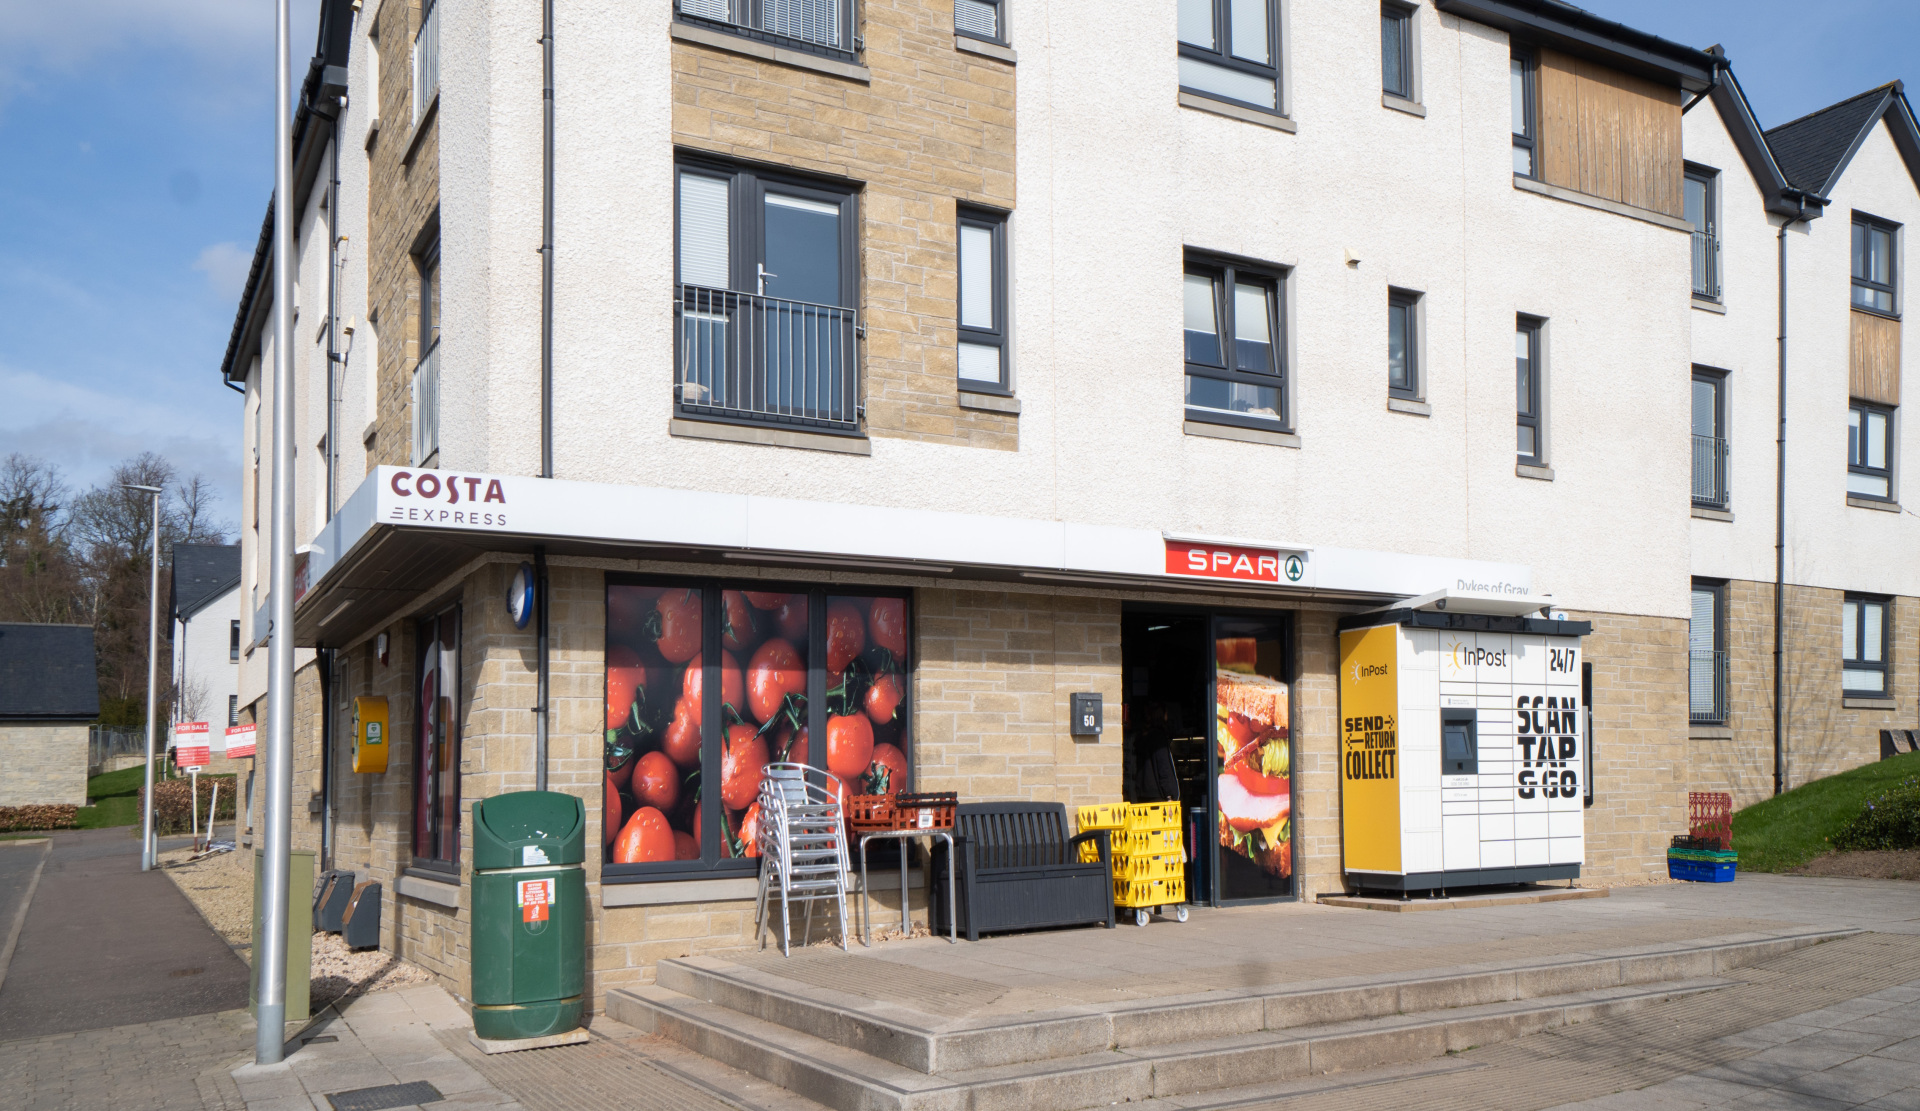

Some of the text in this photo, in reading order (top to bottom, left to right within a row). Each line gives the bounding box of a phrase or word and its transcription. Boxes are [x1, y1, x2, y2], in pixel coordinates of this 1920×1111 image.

[390, 471, 507, 505] COSTA
[408, 507, 507, 526] EXPRESS
[1187, 548, 1277, 577] SPAR
[1361, 663, 1388, 677] InPost
[1463, 646, 1507, 668] InPost
[1550, 647, 1576, 674] 24/7
[1083, 714, 1095, 727] 50
[1344, 715, 1384, 732] SEND
[1516, 695, 1576, 735] SCAN
[1364, 730, 1396, 749] RETURN
[1517, 736, 1577, 768] TAP
[1345, 749, 1396, 780] COLLECT
[1517, 770, 1577, 799] & GO
